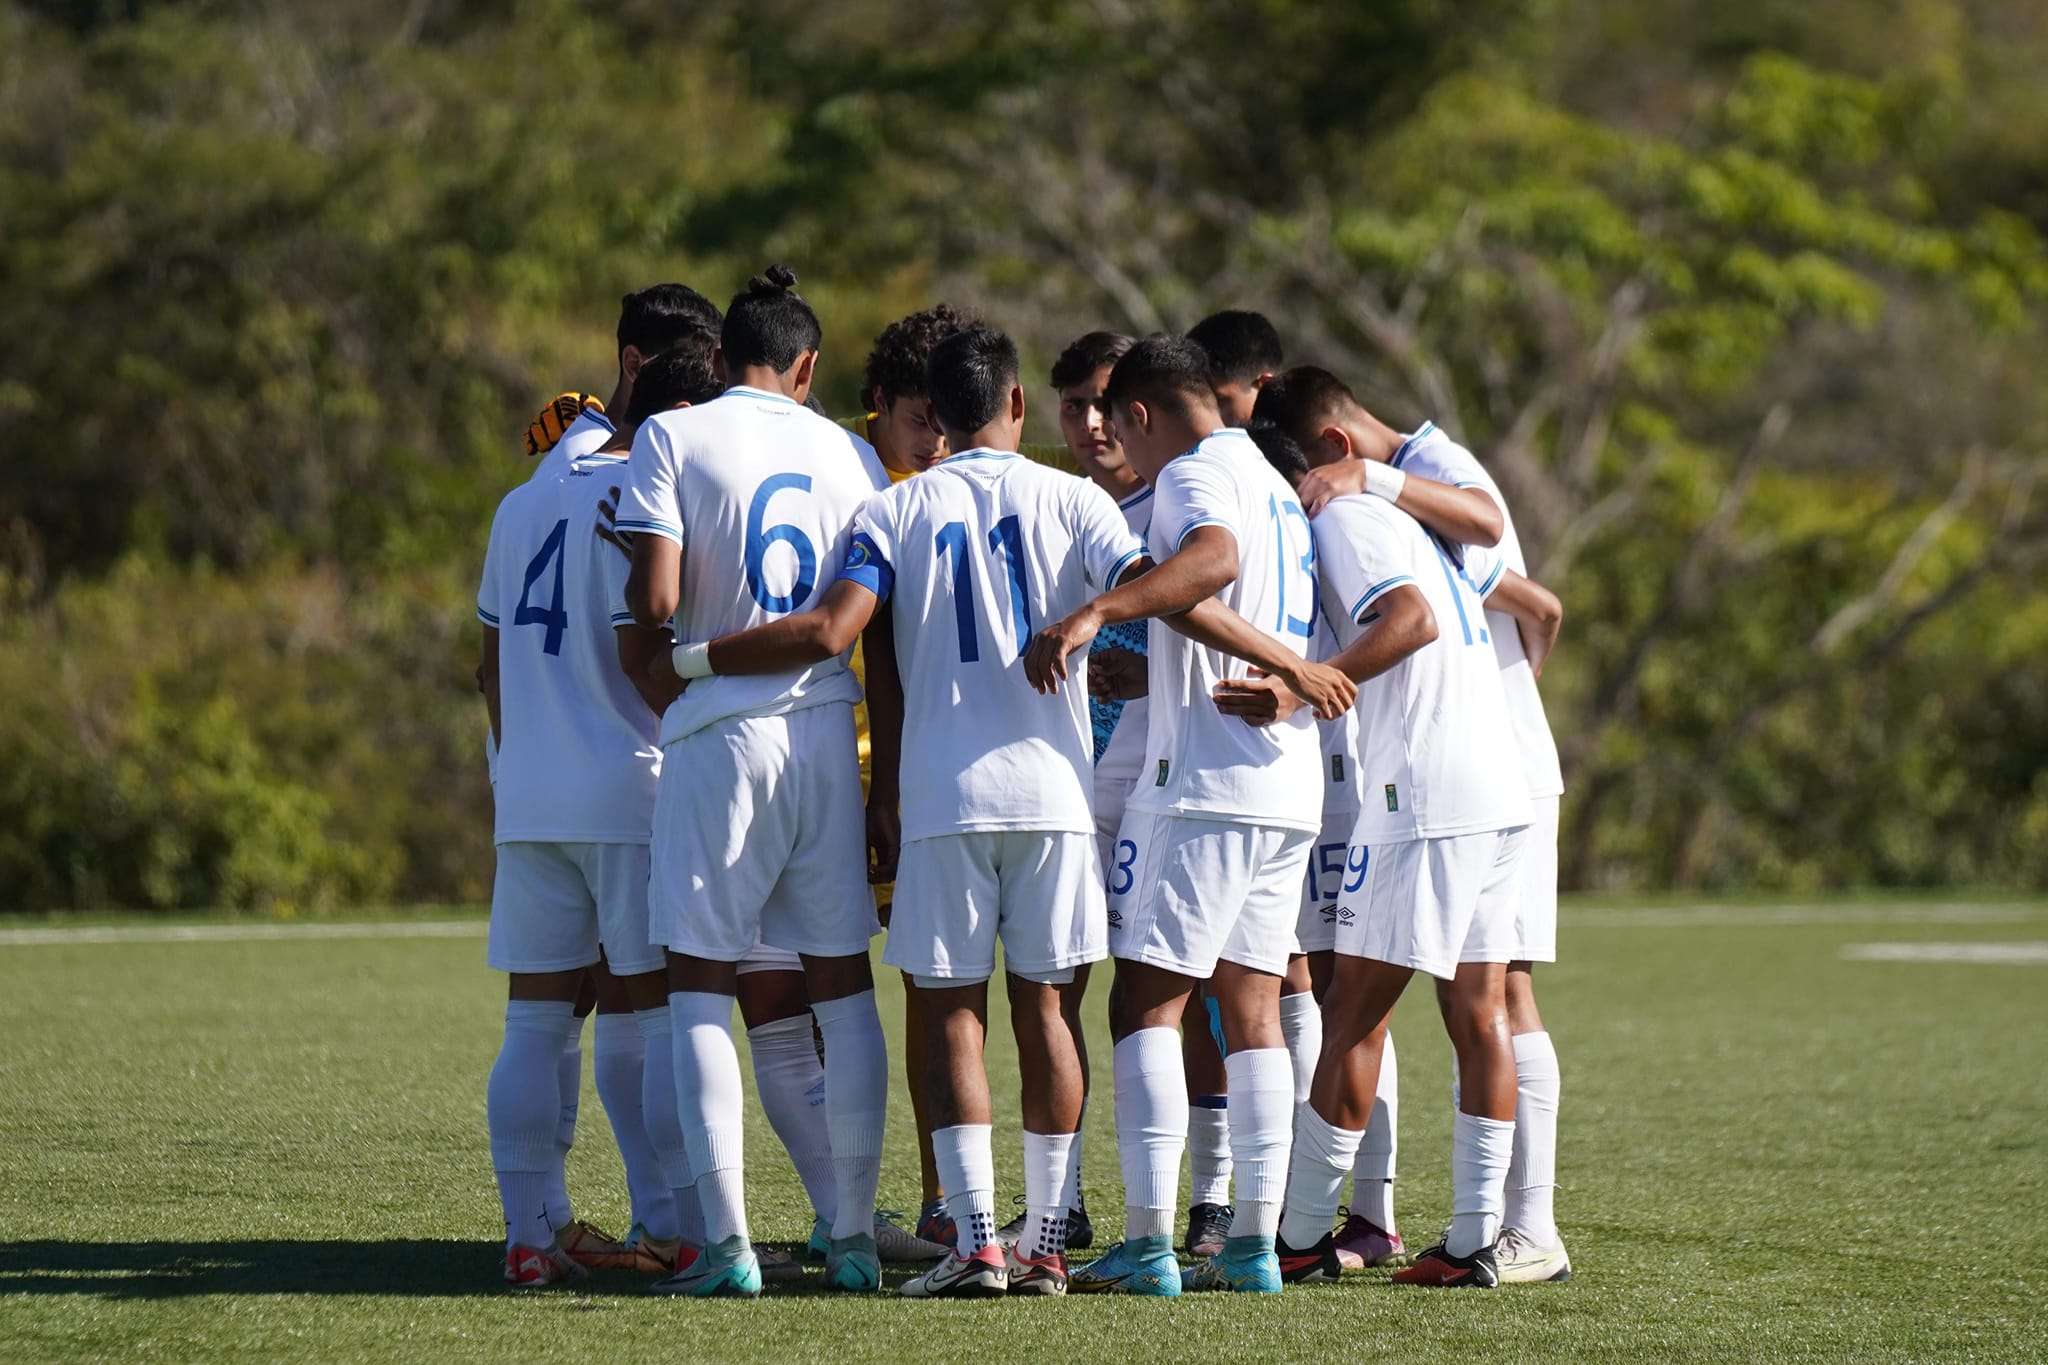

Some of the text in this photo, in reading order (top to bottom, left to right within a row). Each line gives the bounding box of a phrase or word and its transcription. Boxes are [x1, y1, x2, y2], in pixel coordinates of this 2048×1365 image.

[514, 518, 568, 656] 4
[745, 473, 817, 613] 6
[935, 514, 1032, 663] 11
[1269, 491, 1320, 638] 13
